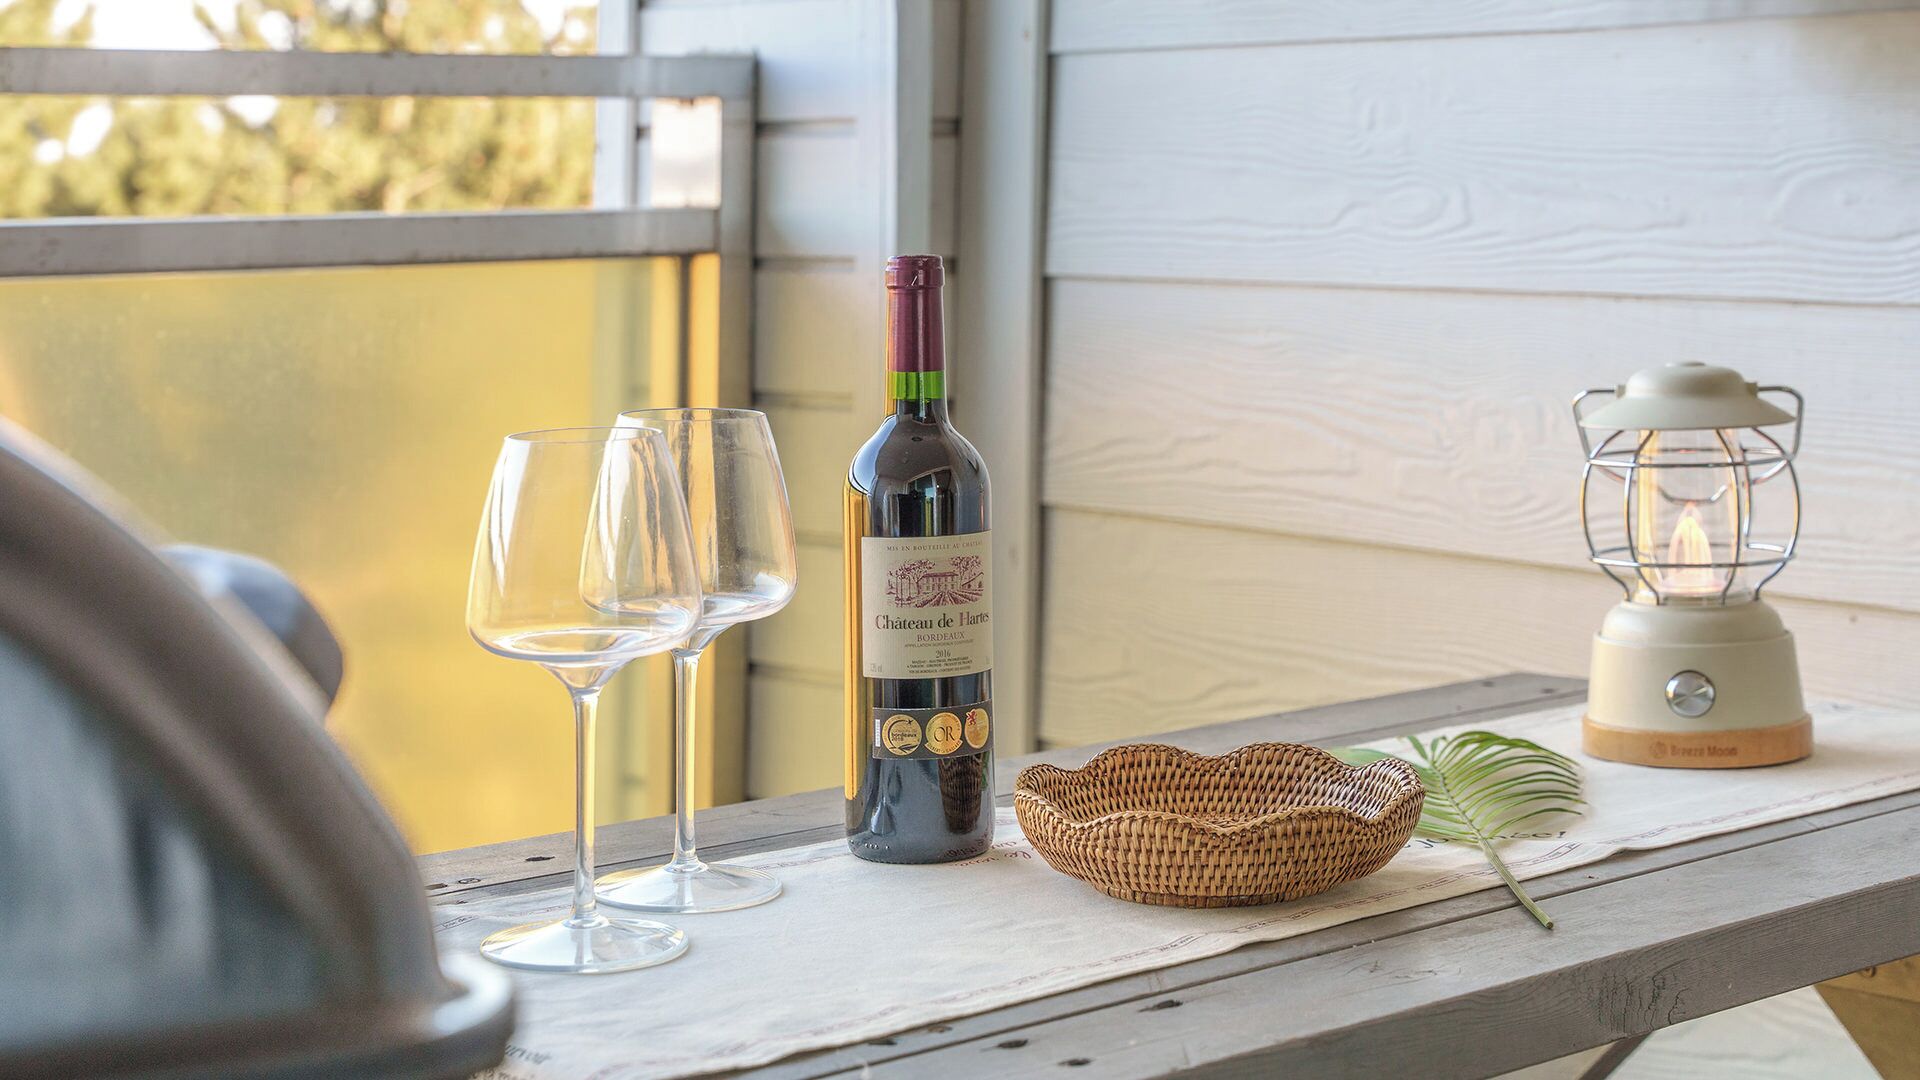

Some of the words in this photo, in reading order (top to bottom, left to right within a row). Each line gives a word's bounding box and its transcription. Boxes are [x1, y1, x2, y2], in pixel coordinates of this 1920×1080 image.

[875, 614, 932, 630] Château
[937, 612, 953, 628] de
[917, 631, 965, 642] BORDEAUX
[935, 649, 951, 658] 2016
[933, 726, 955, 742] OR
